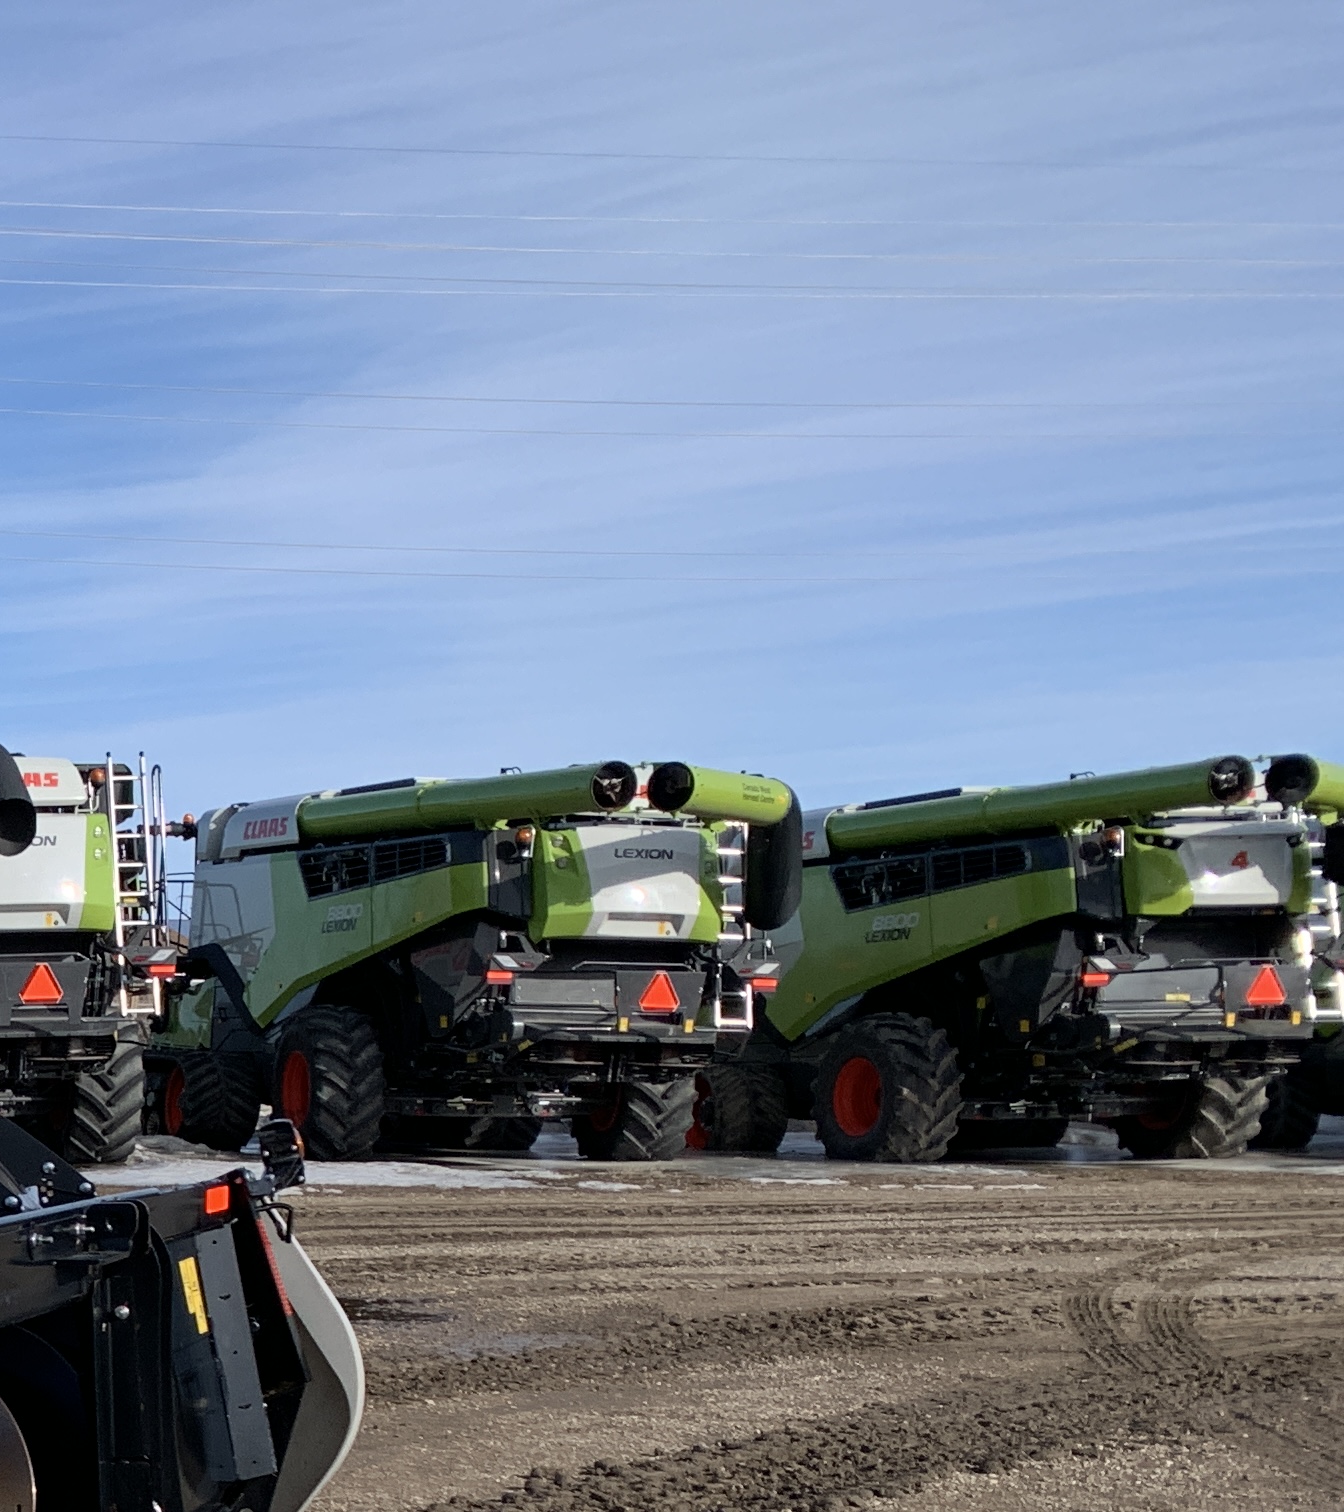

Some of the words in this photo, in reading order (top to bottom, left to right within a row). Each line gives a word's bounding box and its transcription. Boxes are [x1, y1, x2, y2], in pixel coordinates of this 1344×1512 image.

[243, 816, 289, 840] CLAAS
[614, 848, 673, 860] LEXION
[1231, 850, 1249, 869] 4
